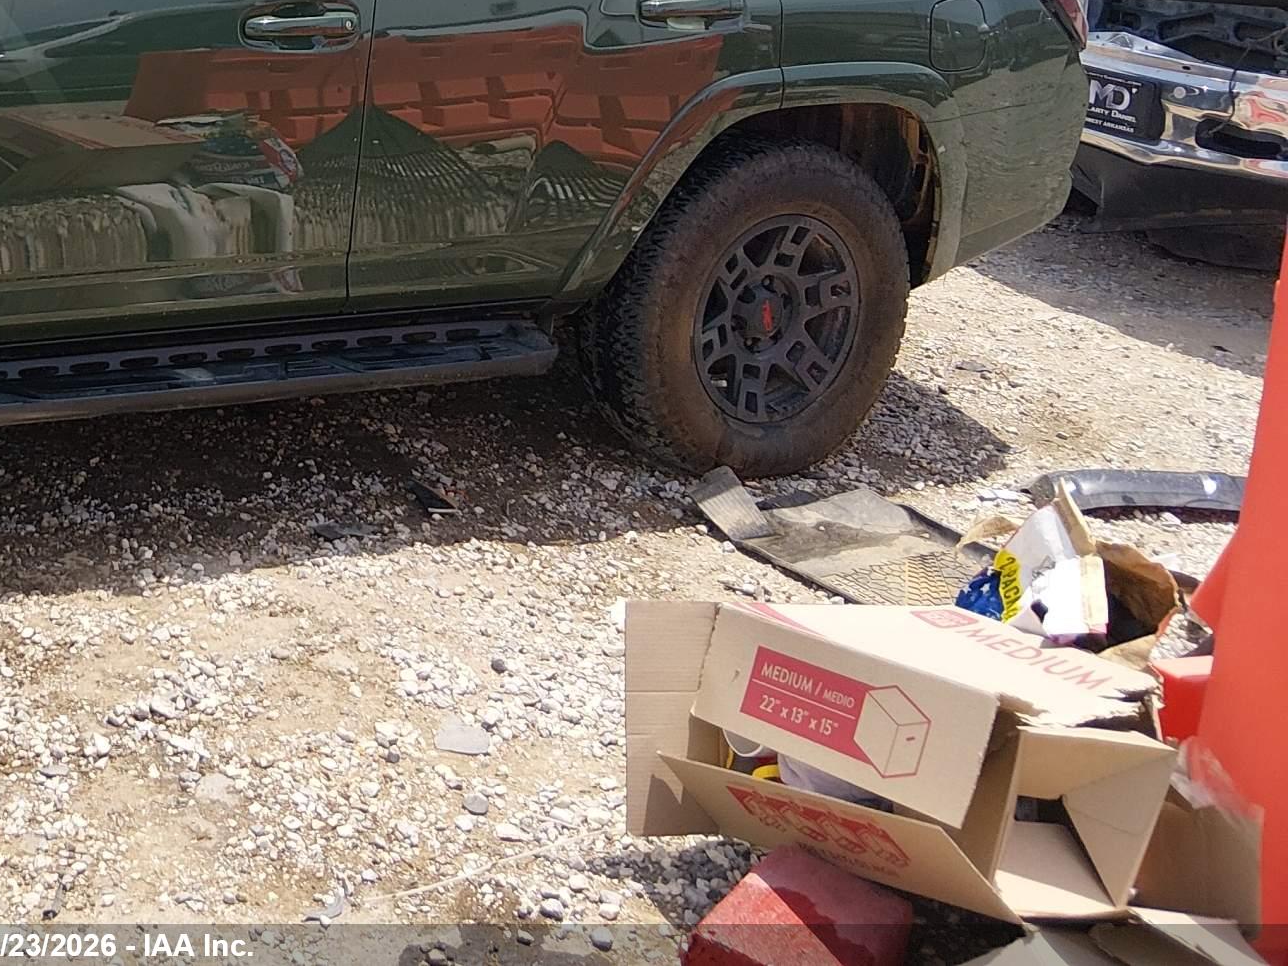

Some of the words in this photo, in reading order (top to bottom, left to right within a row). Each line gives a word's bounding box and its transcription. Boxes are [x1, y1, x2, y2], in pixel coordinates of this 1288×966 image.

[1089, 79, 1130, 110] MD
[955, 628, 1113, 690] MEDIUM
[761, 662, 813, 693] MEDIUM
[823, 689, 855, 708] MEDIO
